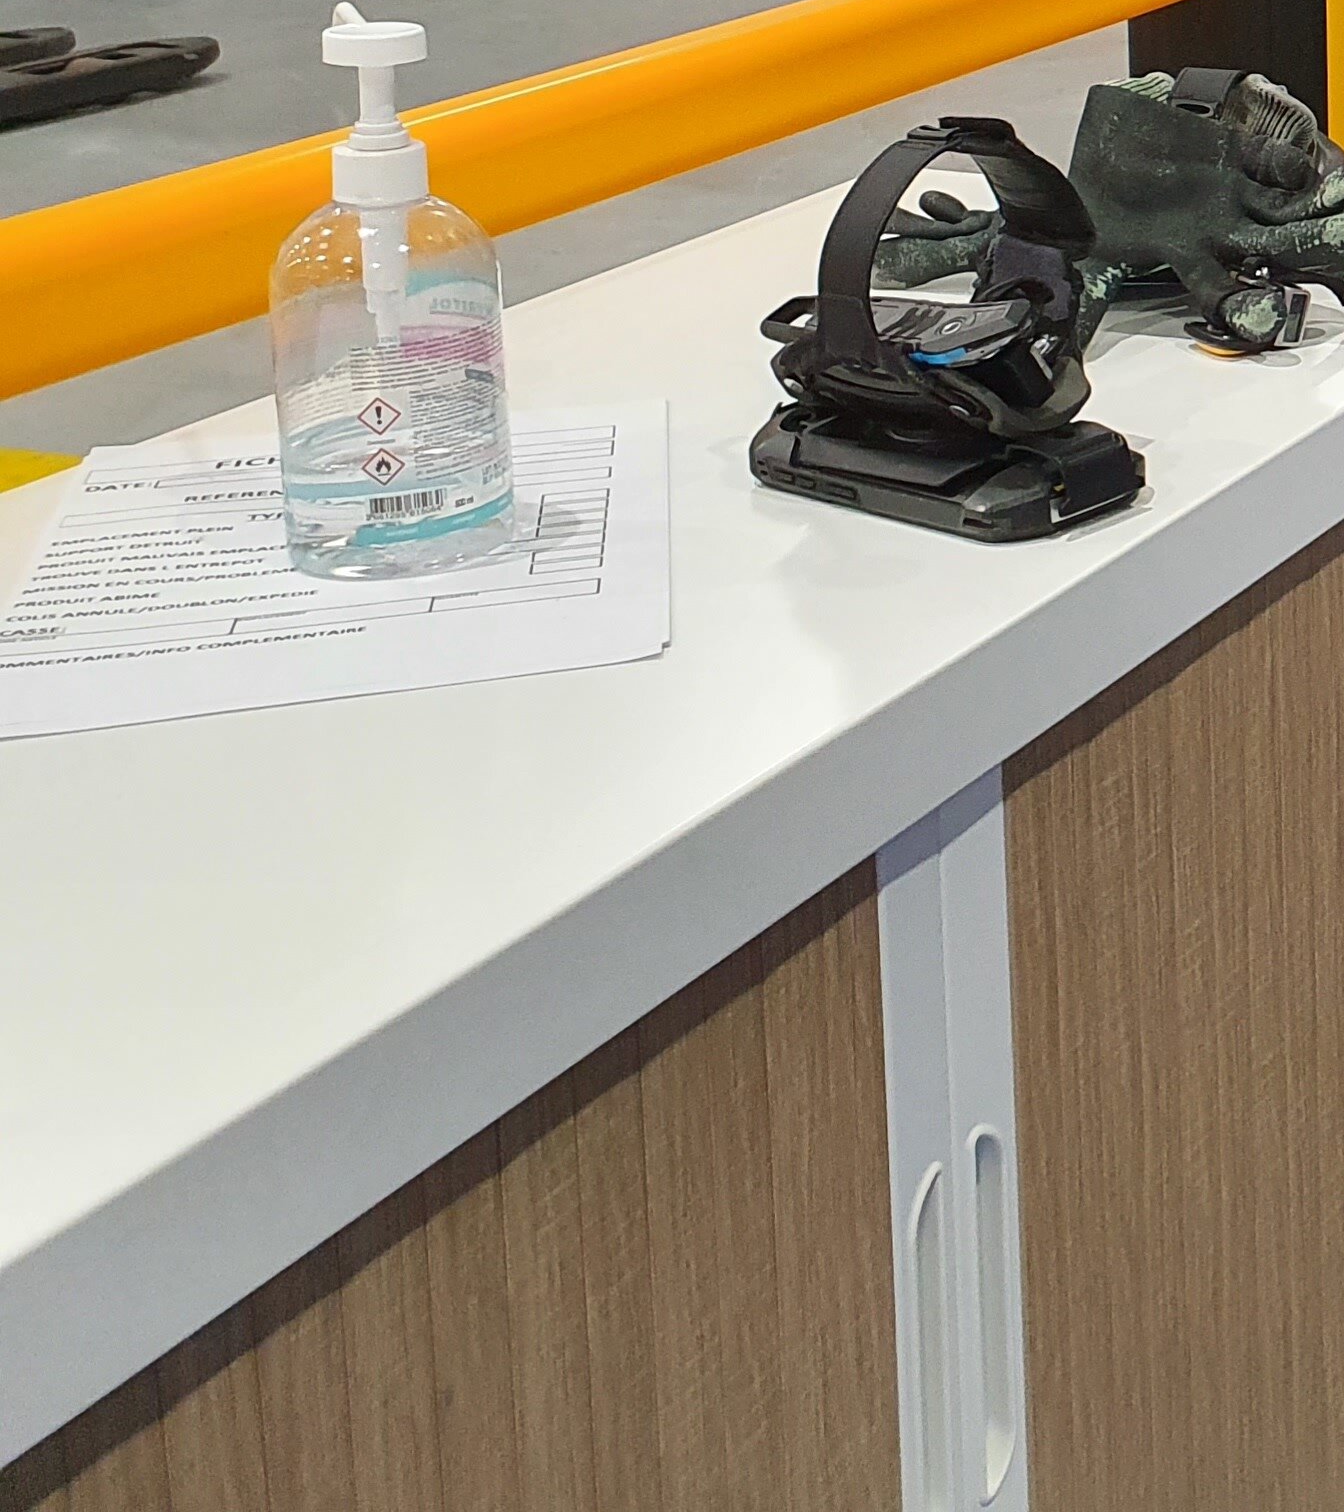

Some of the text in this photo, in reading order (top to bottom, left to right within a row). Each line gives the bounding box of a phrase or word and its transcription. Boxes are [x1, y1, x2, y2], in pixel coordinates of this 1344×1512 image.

[51, 526, 234, 547] EMPLACEMENT PLEIN
[45, 544, 123, 558] SUPPORT
[37, 557, 116, 570] PRODUIT
[120, 550, 204, 561] MAUVAIS
[31, 570, 103, 582] TROUVE
[21, 582, 100, 596] MISSION
[13, 591, 162, 609] PRODUIT ABIME
[5, 612, 58, 623] COLIS
[195, 625, 368, 651] COMPLEMENTAIRE
